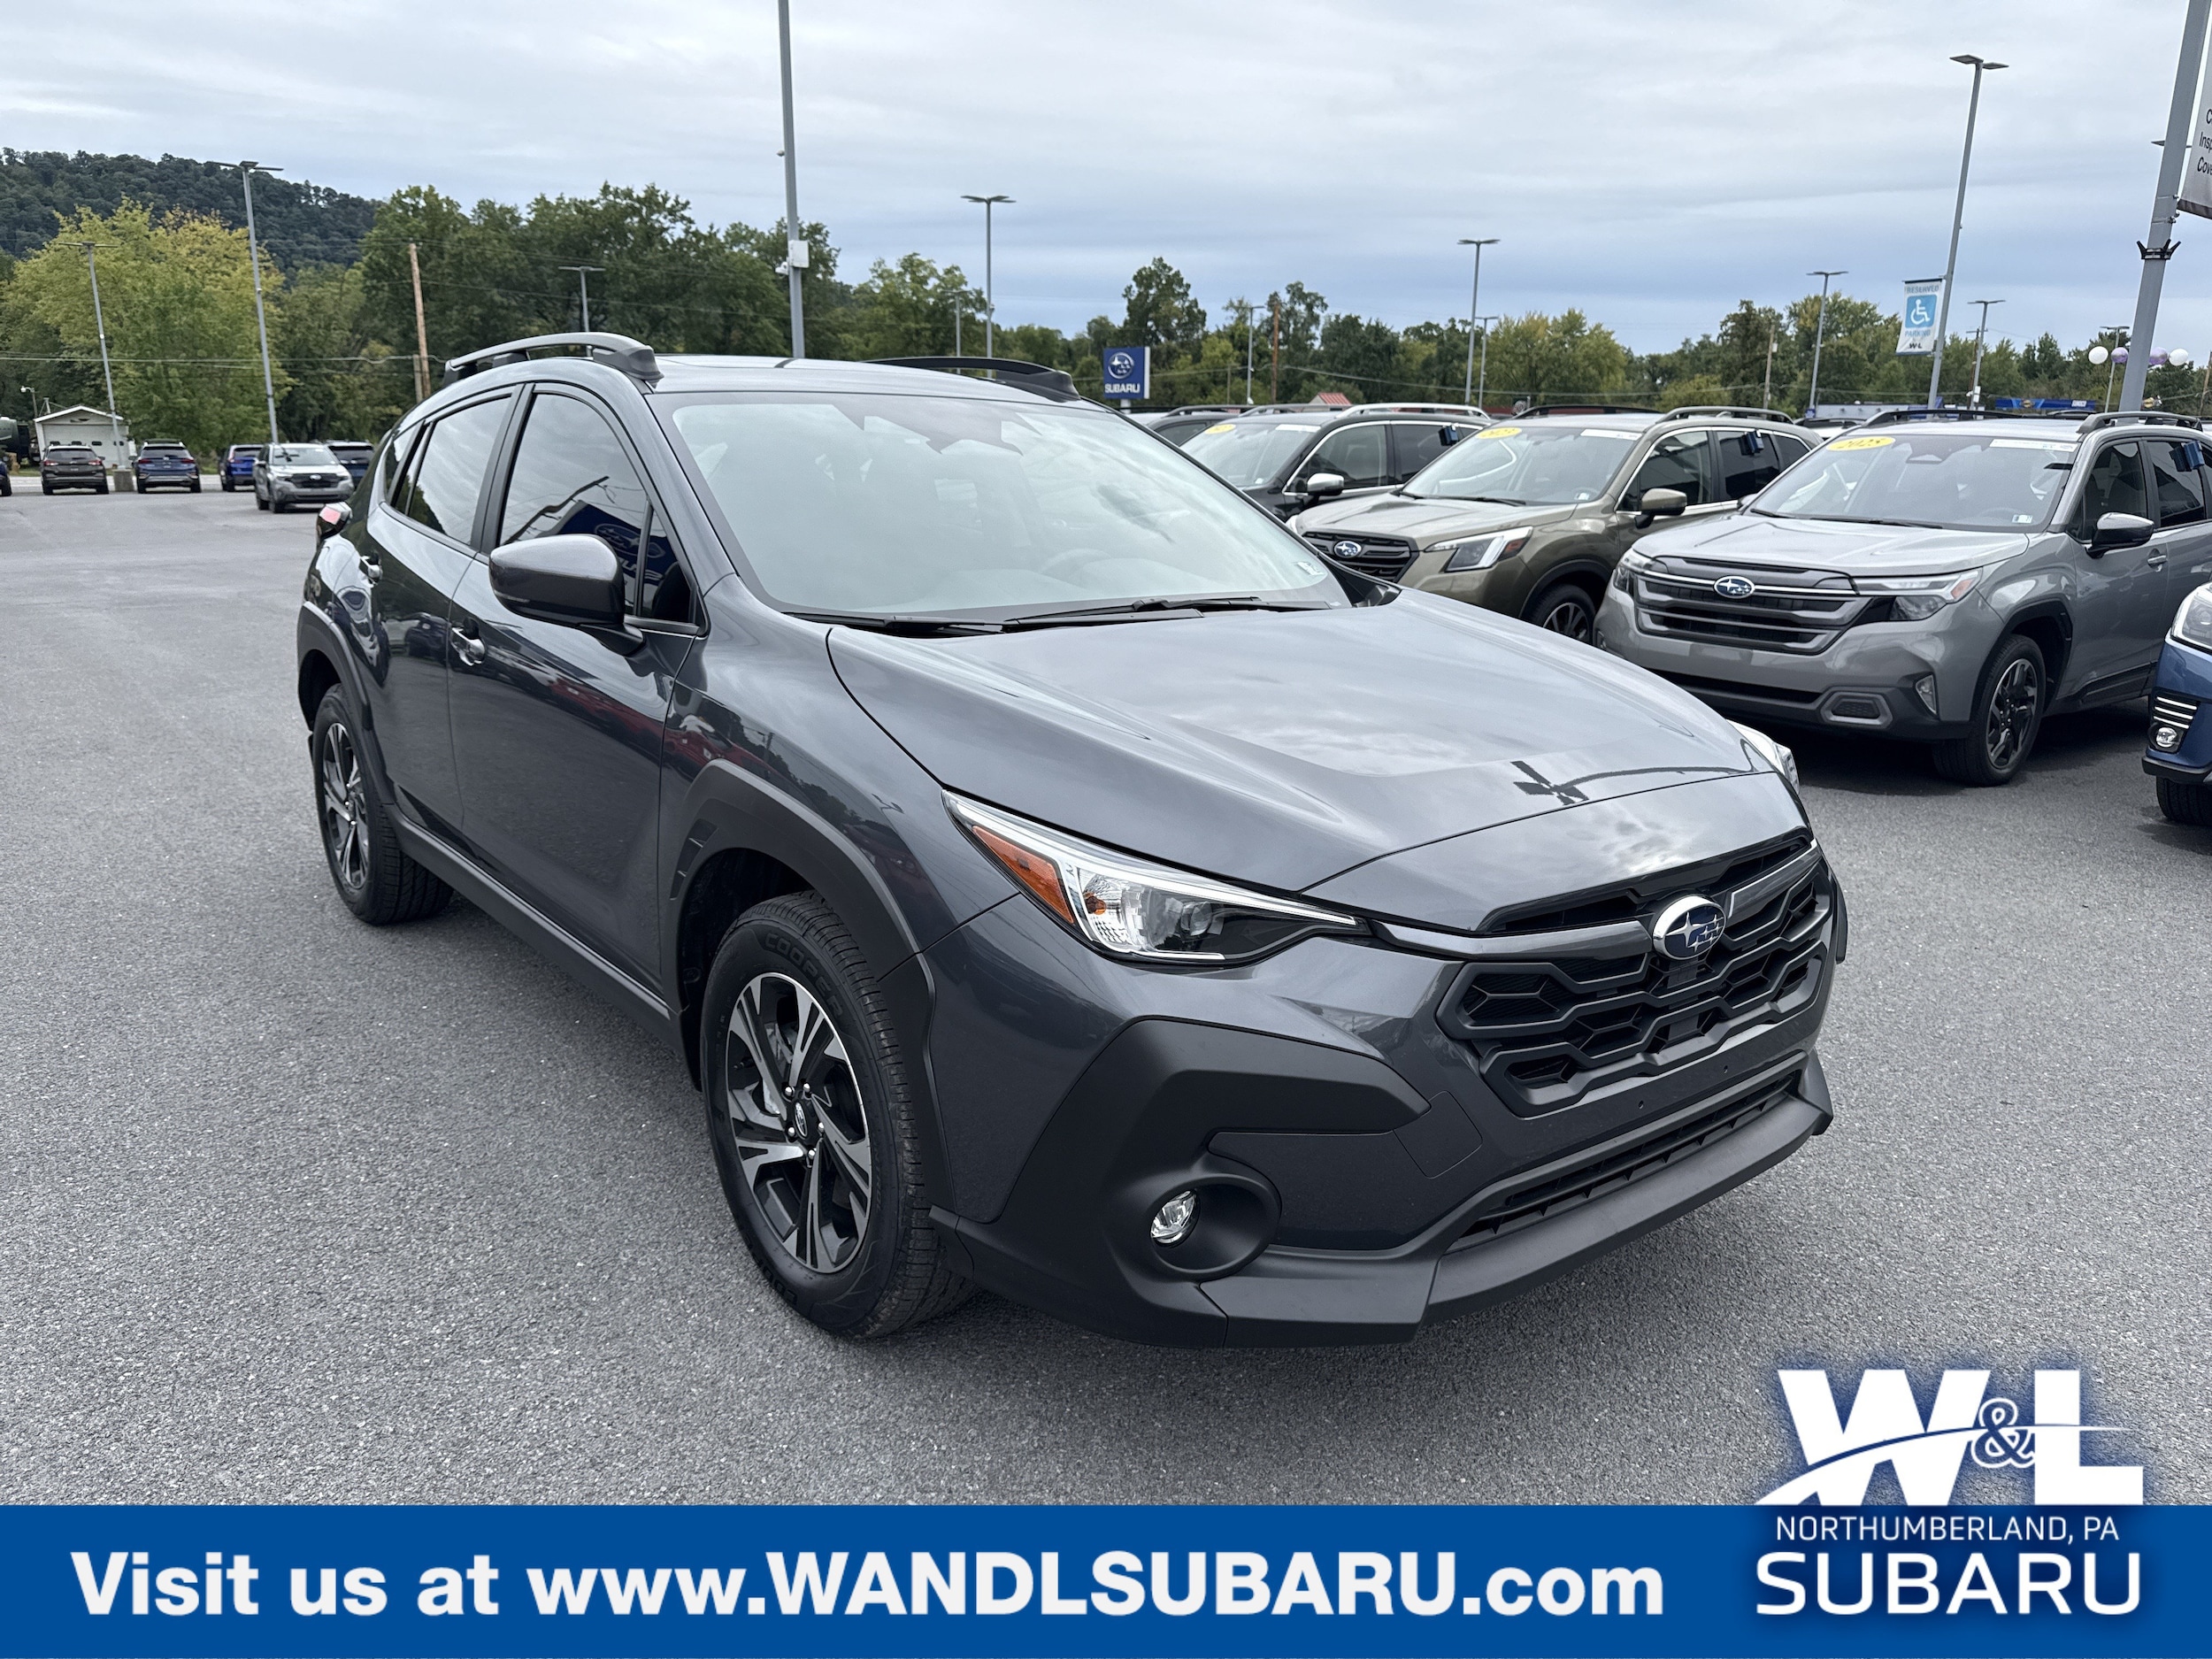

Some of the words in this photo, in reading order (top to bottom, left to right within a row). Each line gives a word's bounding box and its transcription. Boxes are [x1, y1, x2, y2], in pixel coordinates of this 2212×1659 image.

[1906, 285, 1939, 295] RESERVED
[1104, 383, 1141, 394] SUBARU
[764, 931, 845, 1018] COOPER
